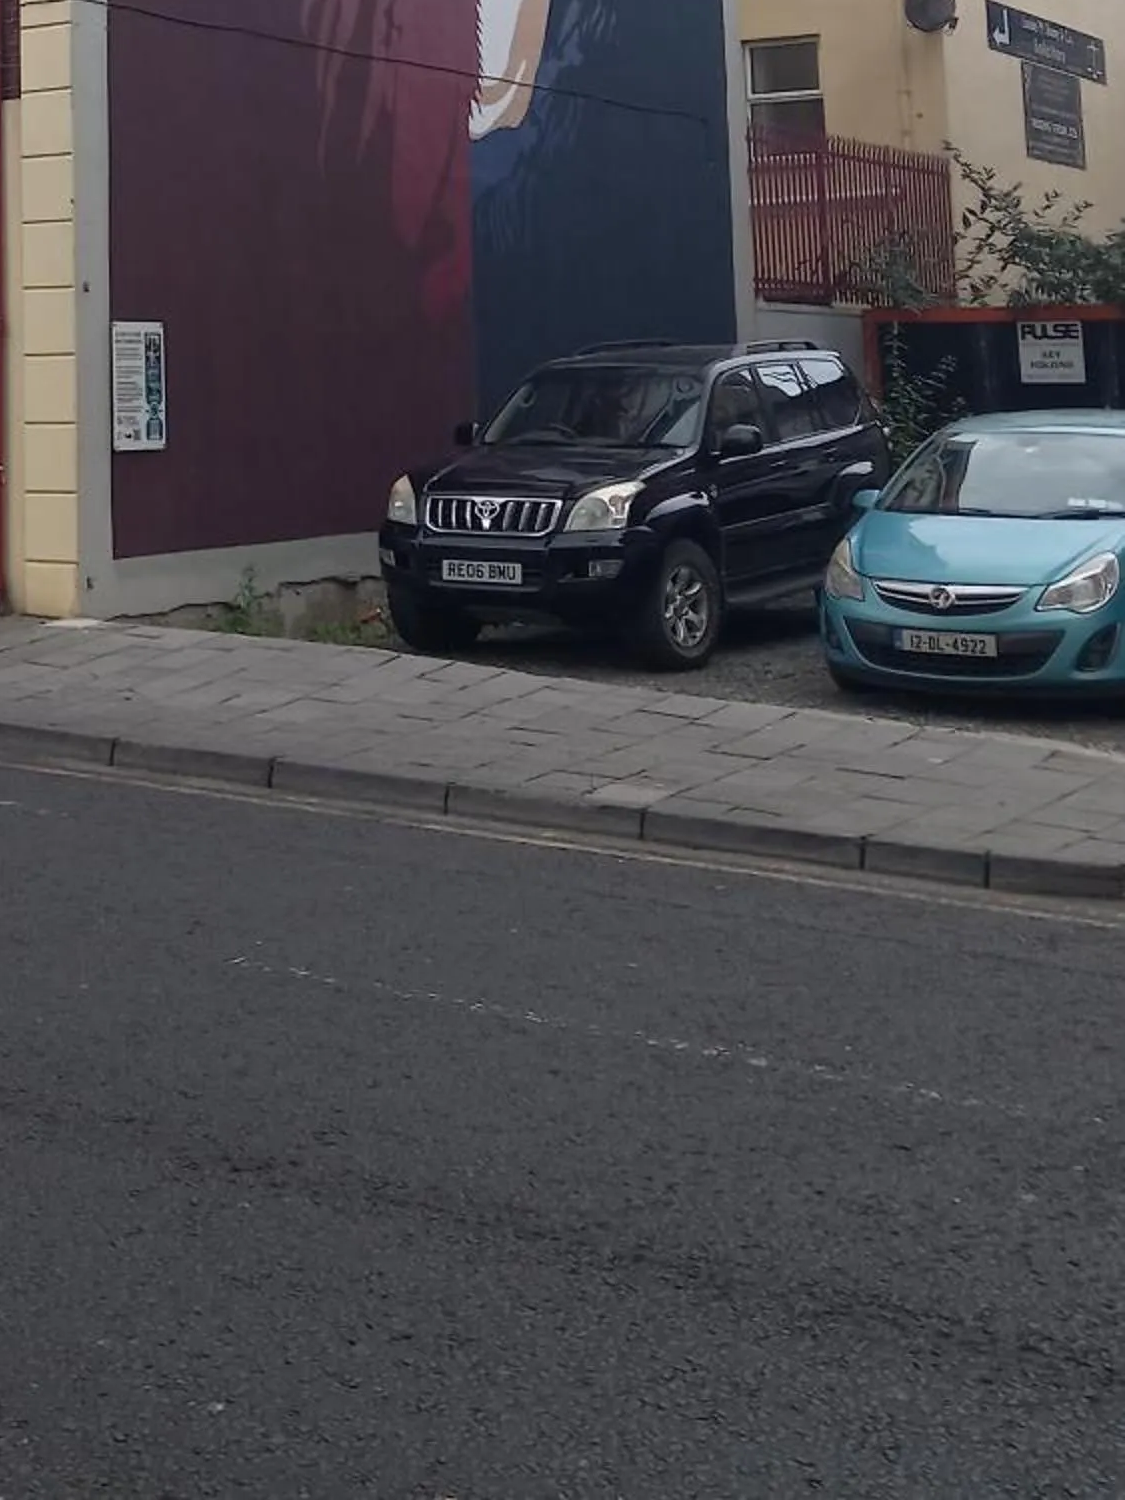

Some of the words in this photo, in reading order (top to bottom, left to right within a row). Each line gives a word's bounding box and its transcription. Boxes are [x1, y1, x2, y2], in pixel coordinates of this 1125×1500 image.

[1020, 323, 1079, 340] PULSE
[447, 562, 484, 579] RE06
[909, 634, 988, 655] 12-DL-4922
